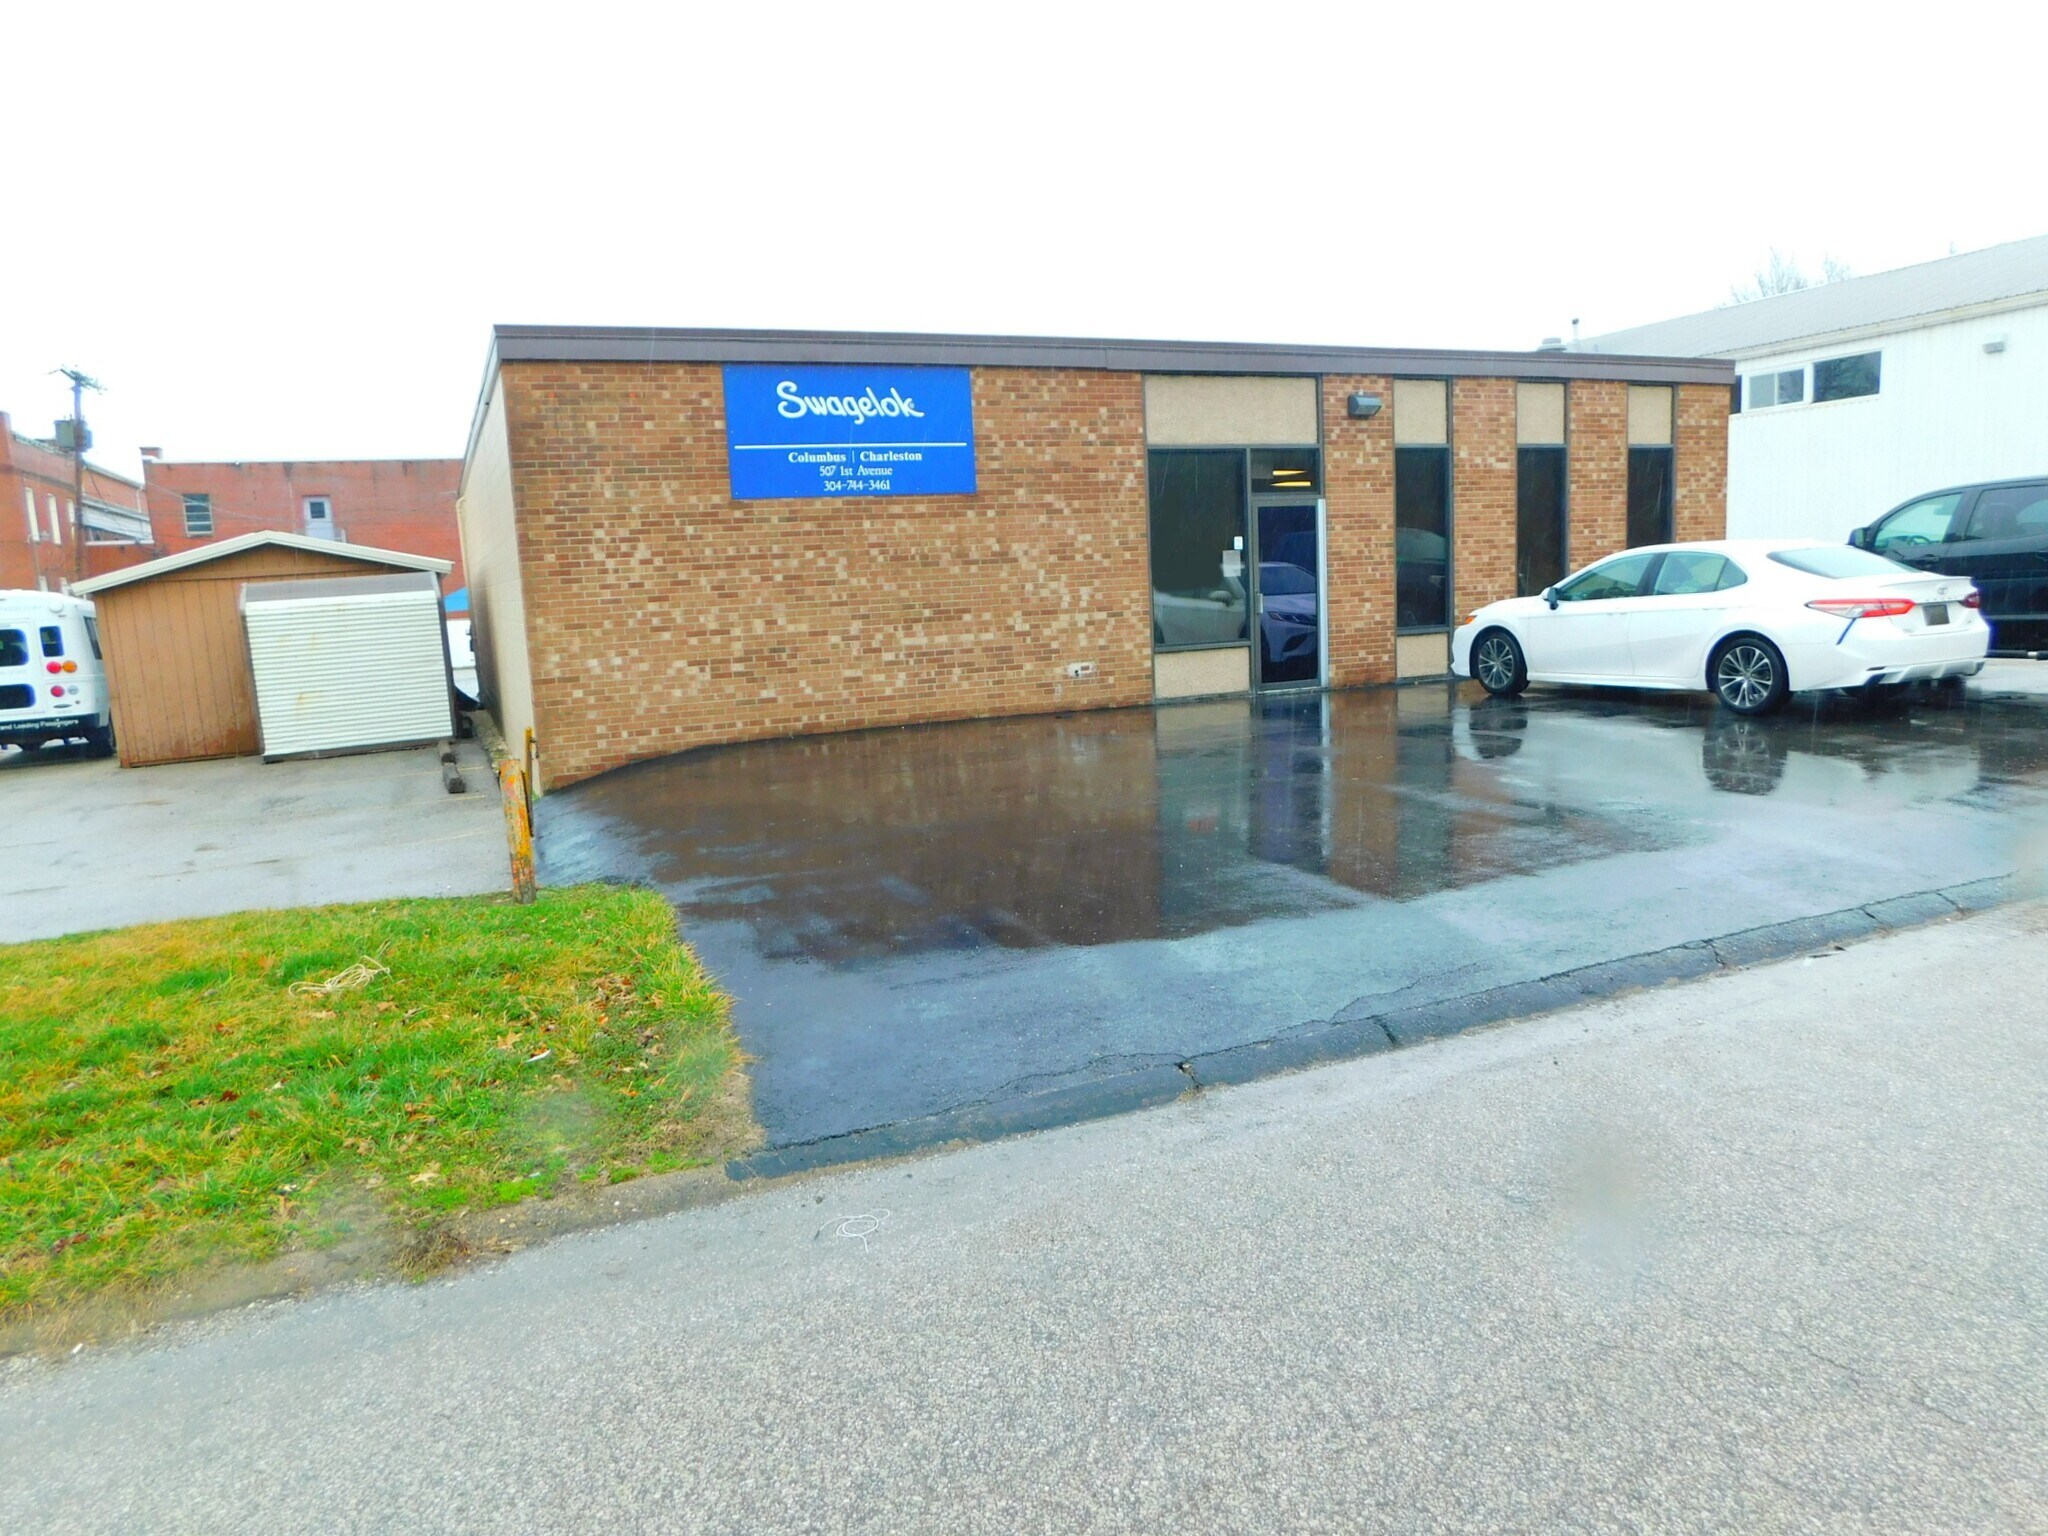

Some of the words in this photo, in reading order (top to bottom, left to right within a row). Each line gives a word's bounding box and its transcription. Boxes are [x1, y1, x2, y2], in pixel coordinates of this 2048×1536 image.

[776, 381, 924, 425] Swagelok
[788, 451, 847, 463] Columbus
[860, 450, 923, 462] Charleston
[819, 465, 836, 476] 507
[840, 465, 853, 476] 1st
[857, 464, 893, 476] Avenue
[823, 479, 891, 491] 304-744-3461
